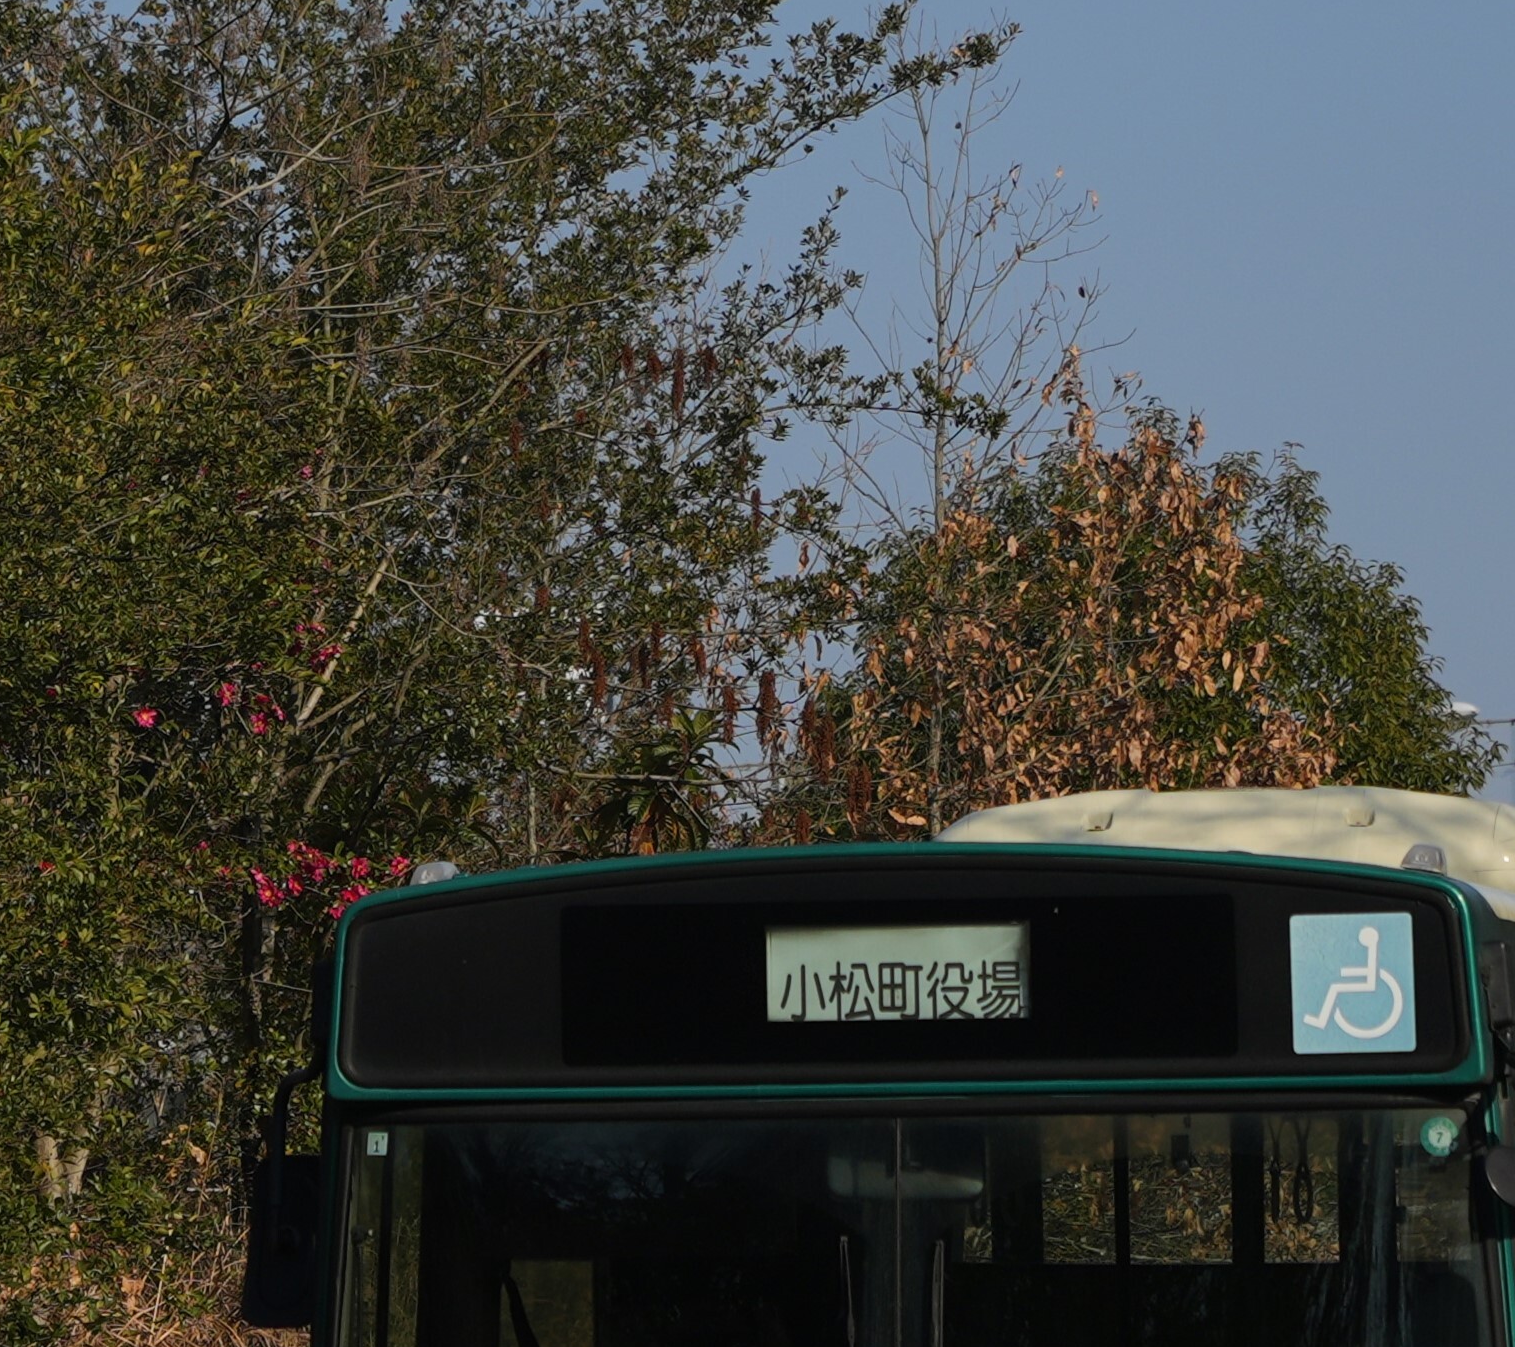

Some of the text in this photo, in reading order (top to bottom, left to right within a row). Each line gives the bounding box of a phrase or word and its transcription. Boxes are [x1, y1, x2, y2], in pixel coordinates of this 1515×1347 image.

[780, 960, 1022, 1022] 小松町役場
